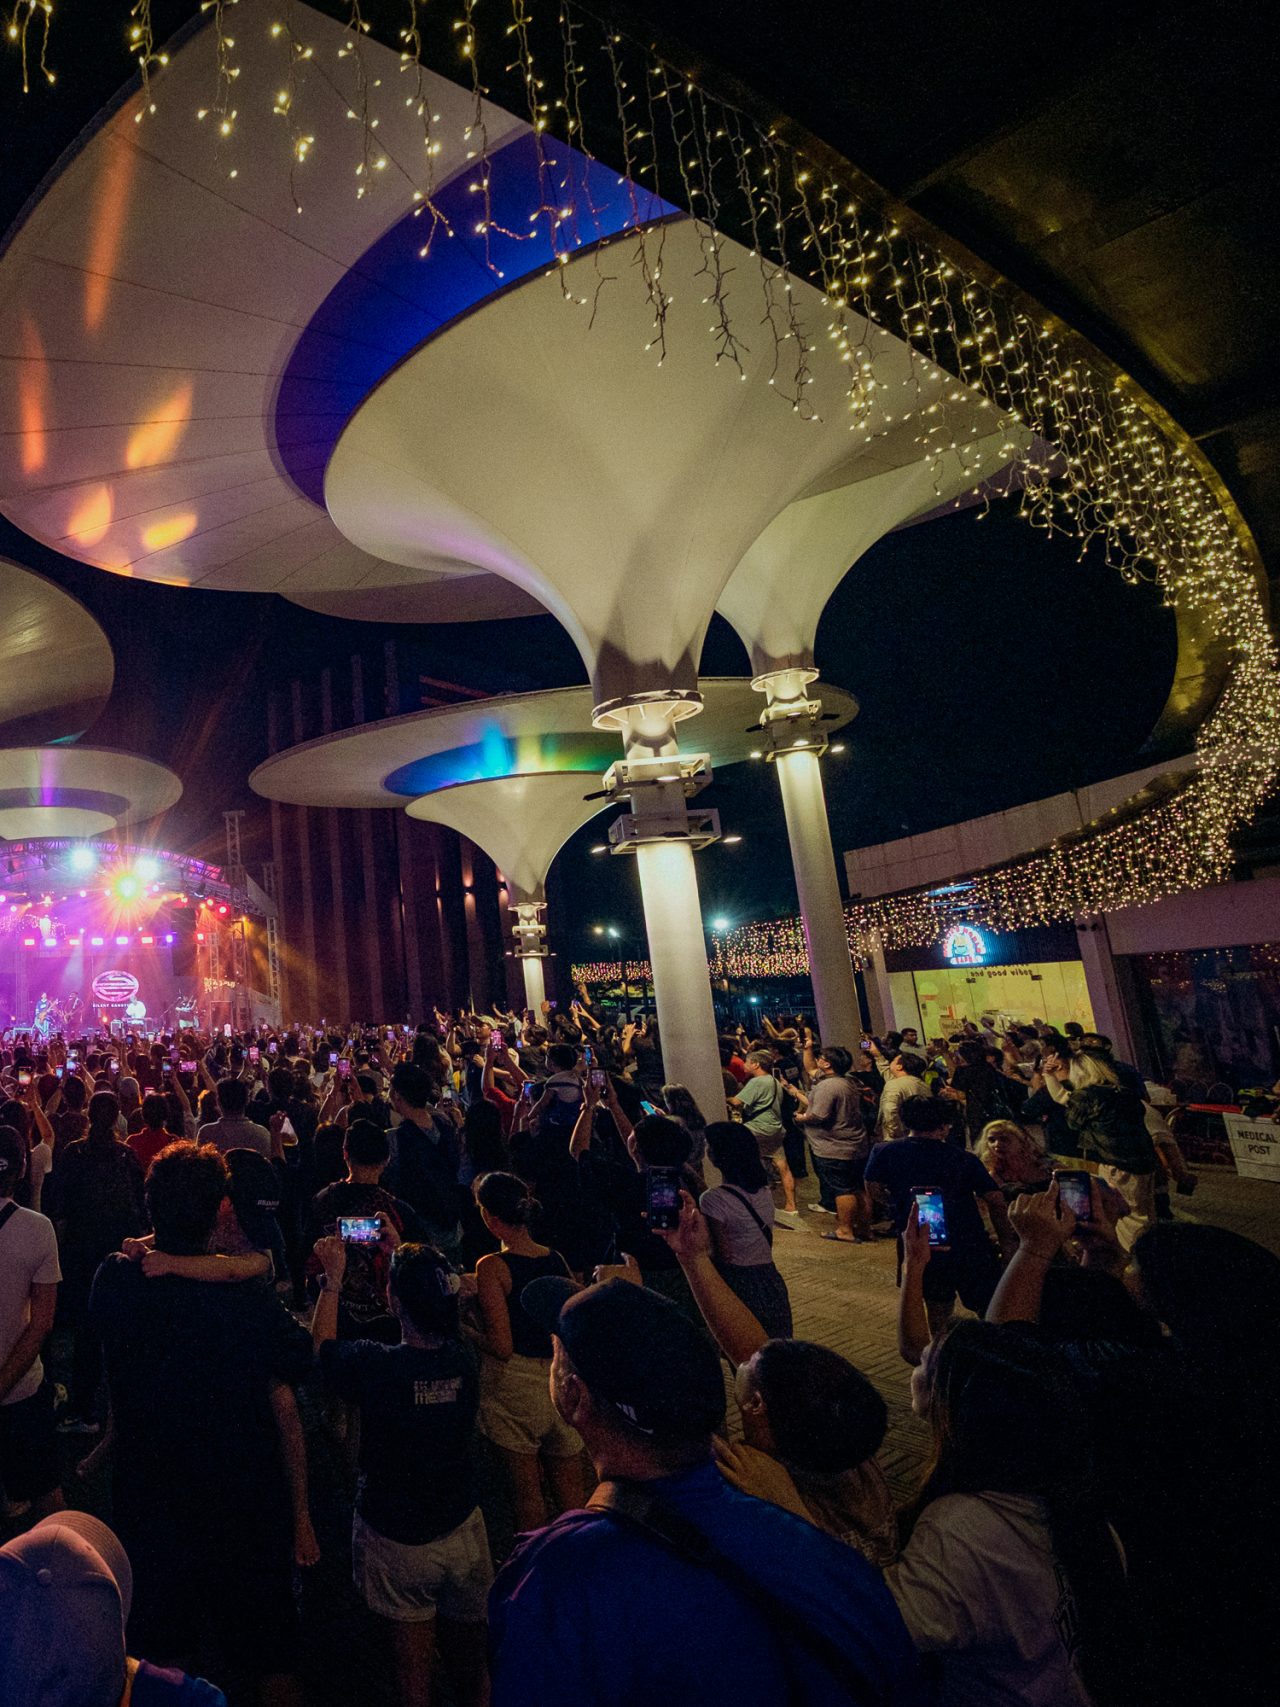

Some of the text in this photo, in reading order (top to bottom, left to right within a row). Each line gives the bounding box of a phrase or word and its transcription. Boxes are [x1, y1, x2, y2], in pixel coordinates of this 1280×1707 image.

[987, 969, 1007, 979] good
[1237, 1130, 1278, 1156] MEDICAL POST
